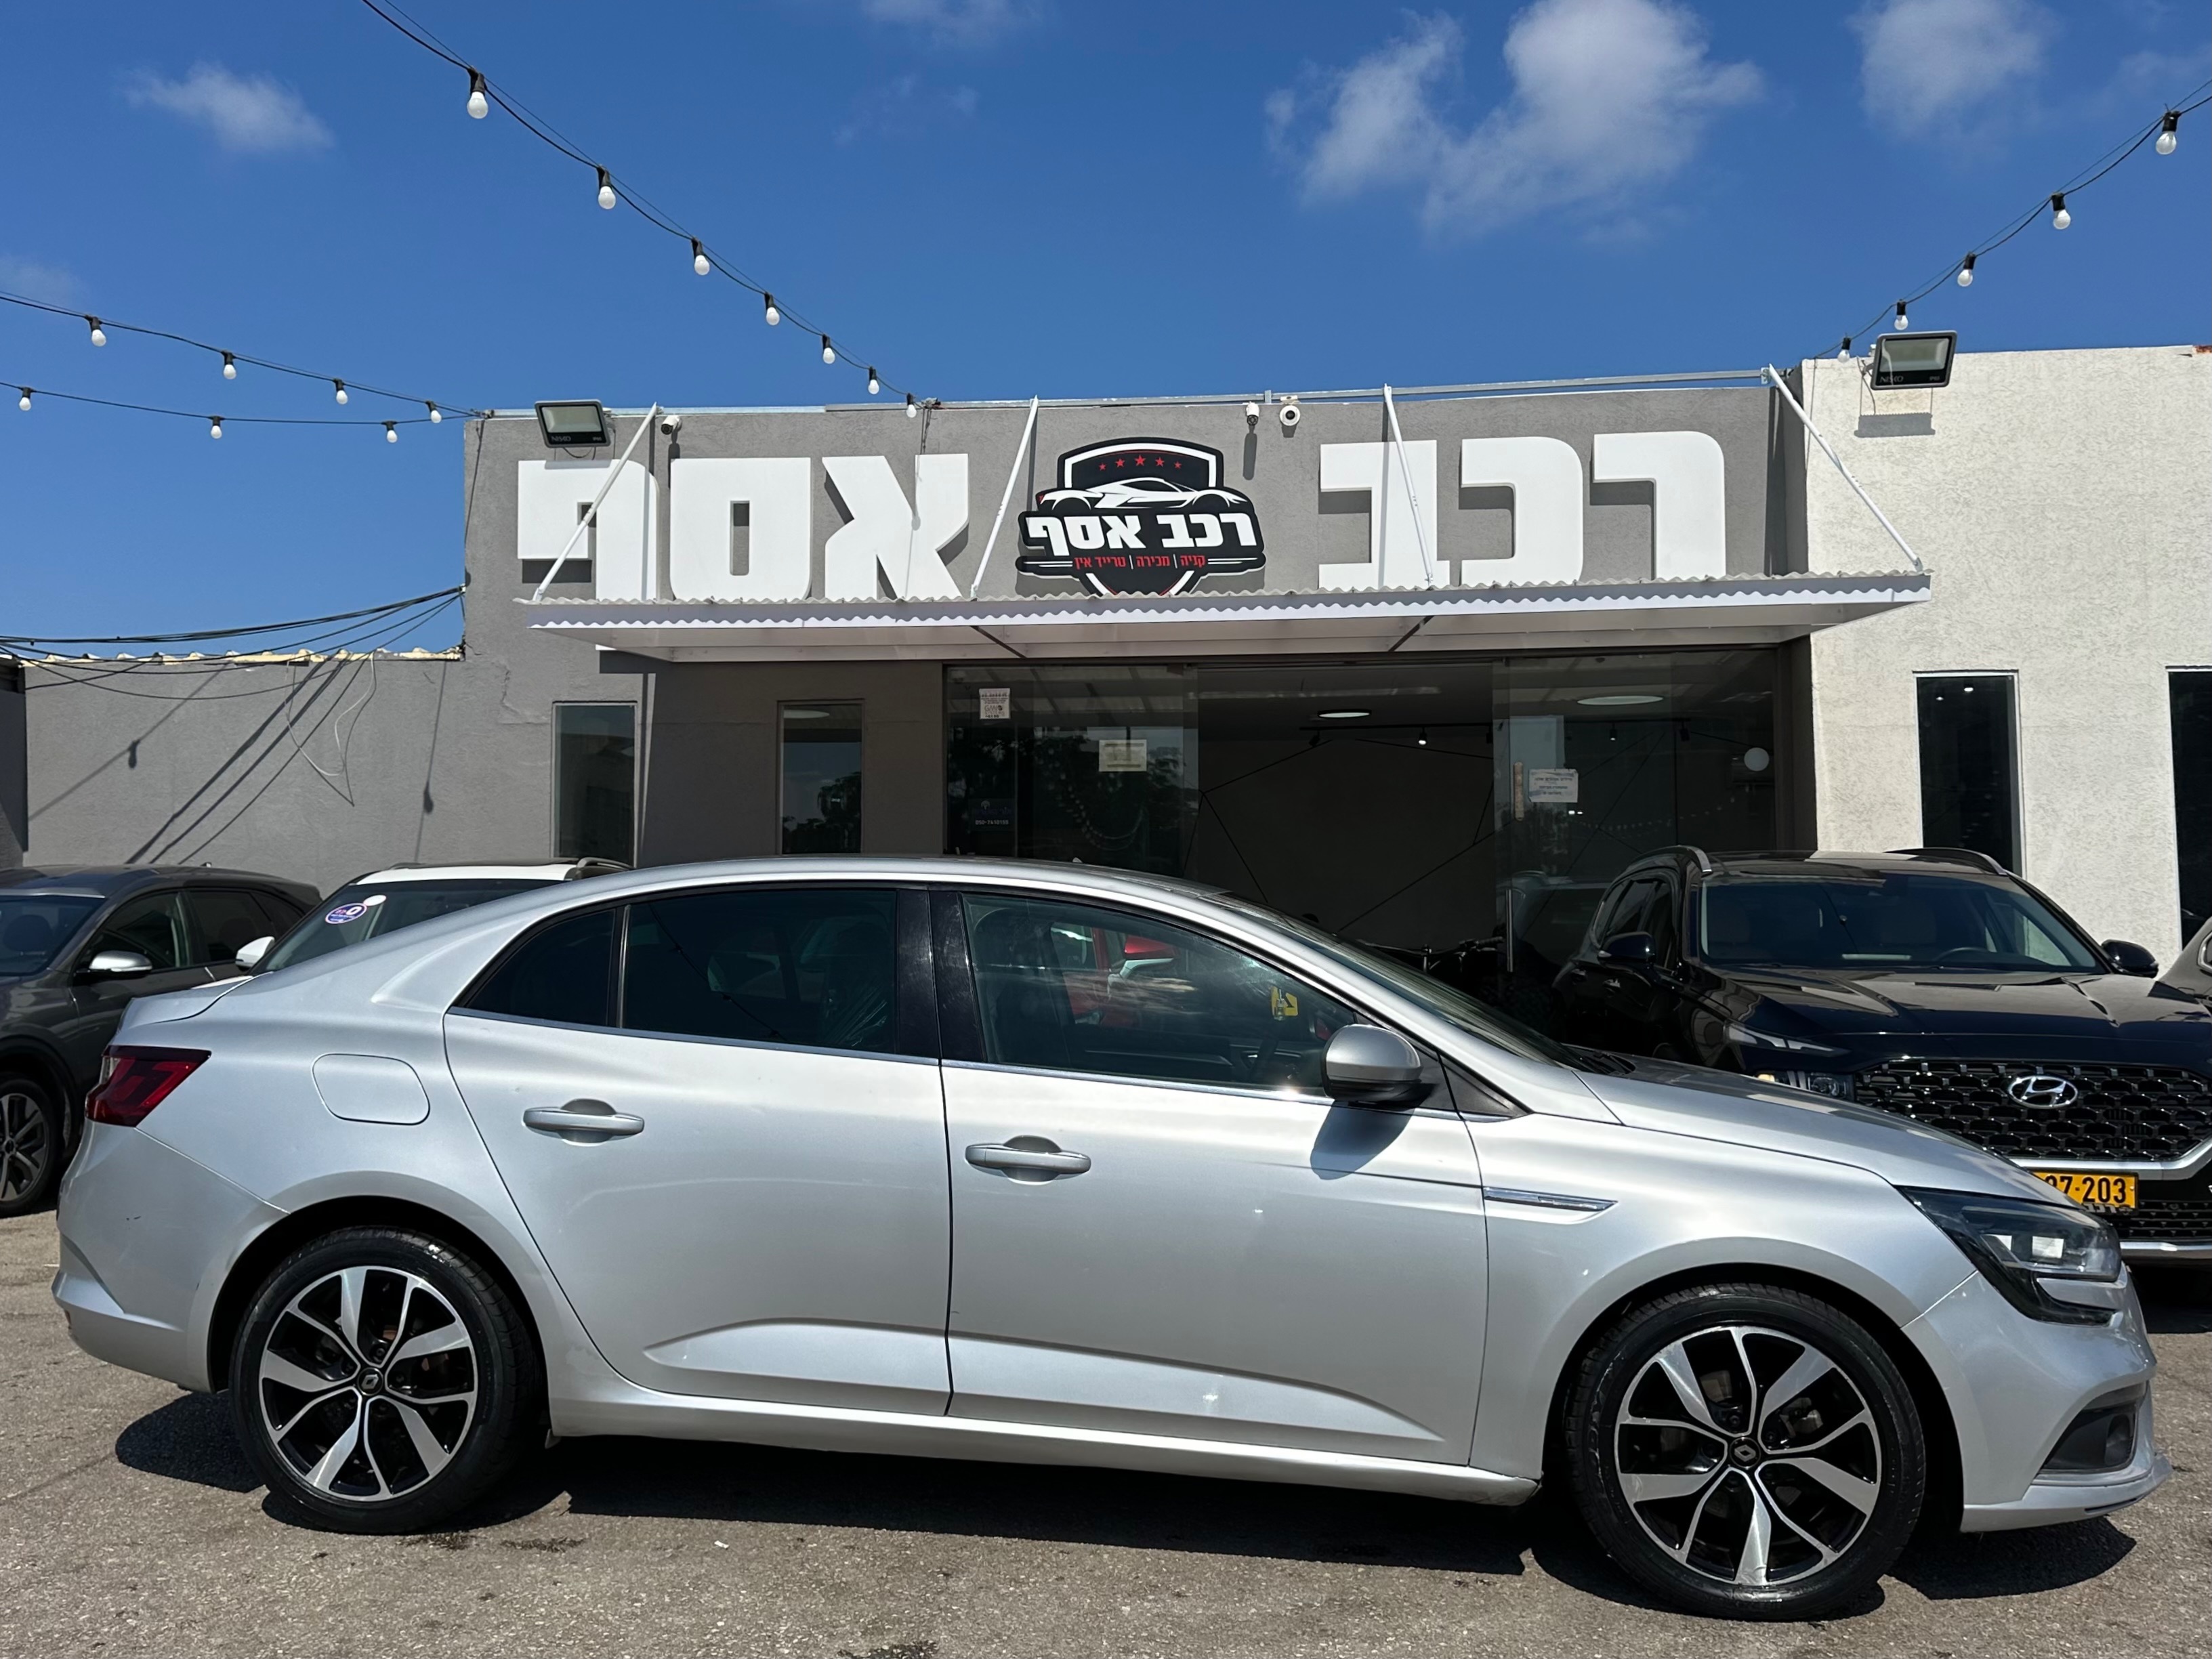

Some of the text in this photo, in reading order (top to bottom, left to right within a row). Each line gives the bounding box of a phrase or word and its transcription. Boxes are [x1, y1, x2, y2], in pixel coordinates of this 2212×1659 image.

[518, 430, 1726, 602] רכב אסף
[1025, 513, 1257, 556] רכב אסף
[1074, 554, 1206, 570] קניה מכירה טרייד אין
